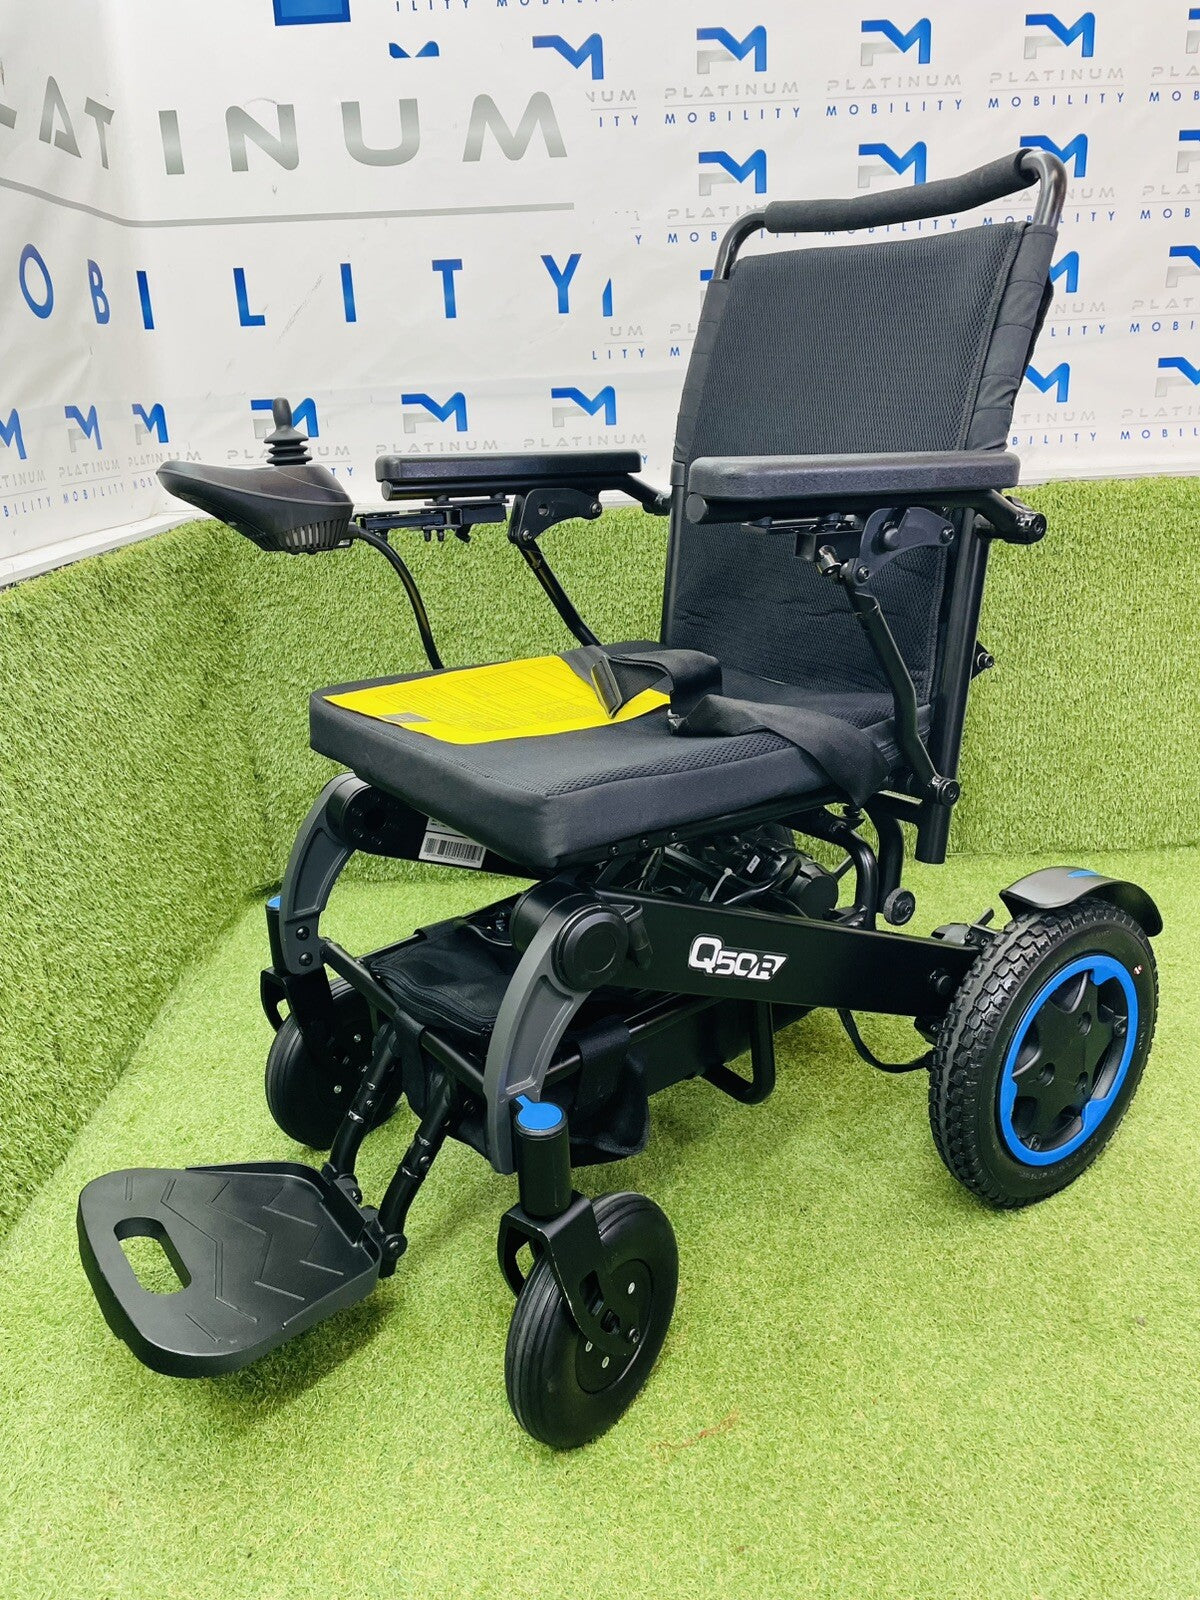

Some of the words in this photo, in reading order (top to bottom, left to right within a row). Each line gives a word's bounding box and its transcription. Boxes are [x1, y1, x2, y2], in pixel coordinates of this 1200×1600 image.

[827, 74, 961, 91] PLATINUM
[989, 67, 1124, 83] PLATINUM
[664, 81, 798, 99] PLATINUM
[826, 99, 962, 116] MOBILITY
[988, 92, 1124, 109] MOBILITY
[665, 107, 799, 124] MOBILITY
[0, 75, 567, 175] ATINUM
[376, 439, 498, 454] PLATINUM
[524, 434, 646, 448] PLATINUM
[58, 459, 120, 478] PLATINUM
[0, 469, 46, 489] TINUM
[63, 482, 125, 504] MOBILITY
